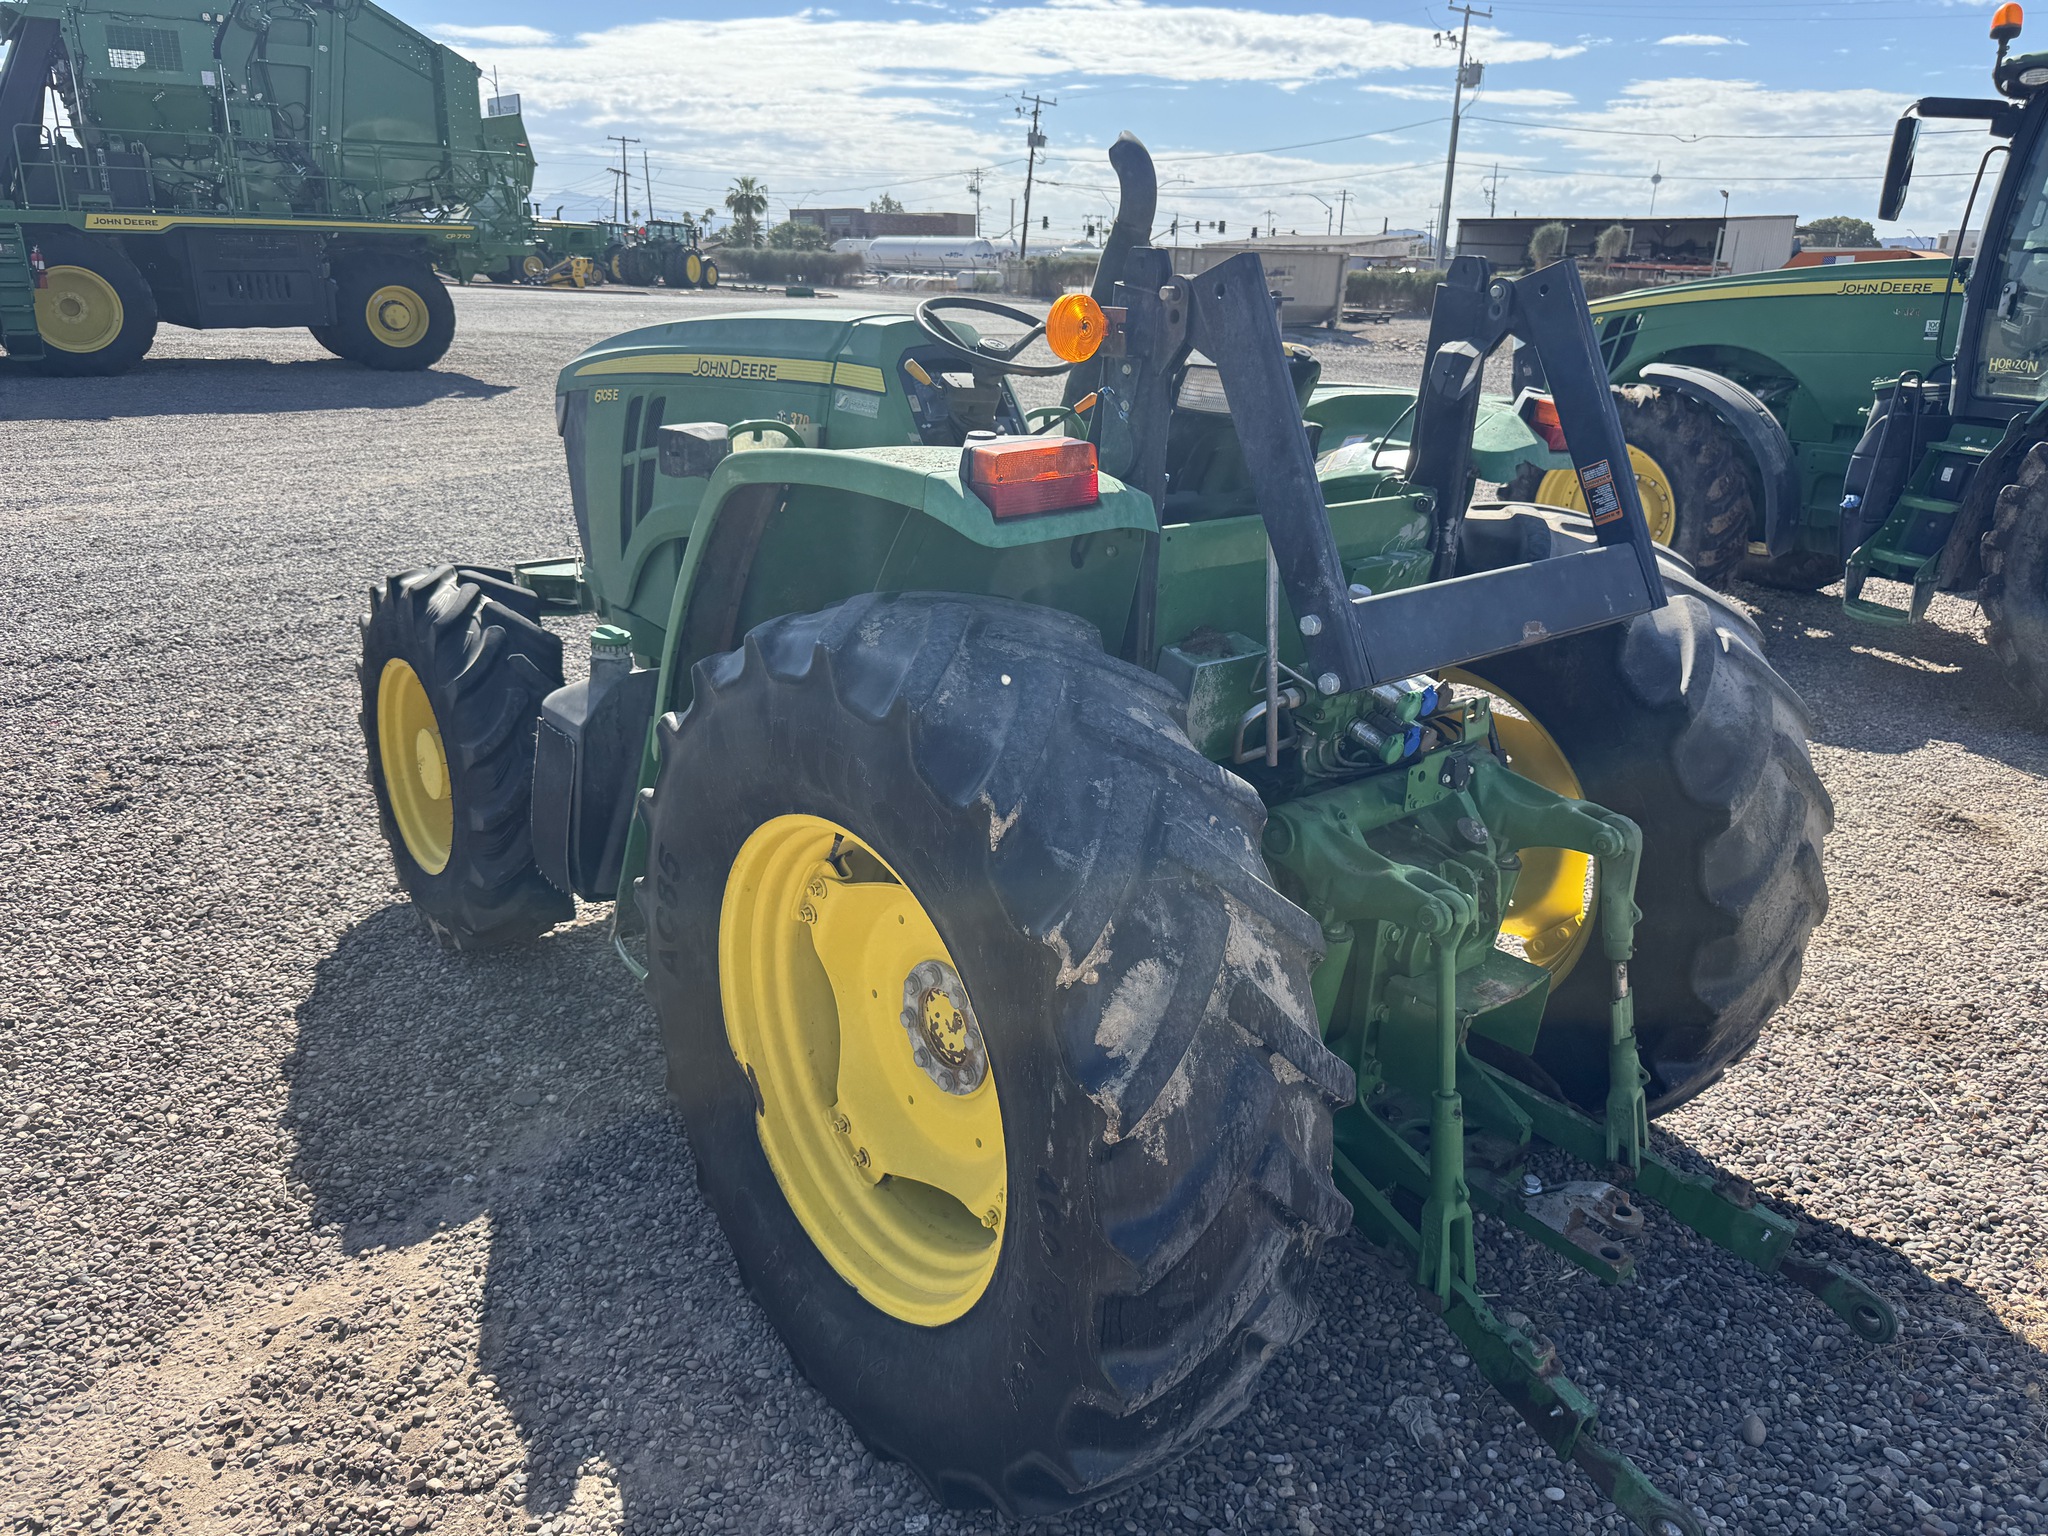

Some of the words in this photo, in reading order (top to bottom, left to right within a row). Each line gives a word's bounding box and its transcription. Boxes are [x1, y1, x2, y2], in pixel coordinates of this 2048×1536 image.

[93, 217, 121, 225] JOHN
[123, 217, 158, 226] DEERE
[1837, 282, 1878, 294] JOHN
[1880, 281, 1933, 293] DEERE
[692, 357, 729, 376] JOHN
[730, 359, 778, 379] DEERE
[1988, 357, 2039, 374] HORIZON
